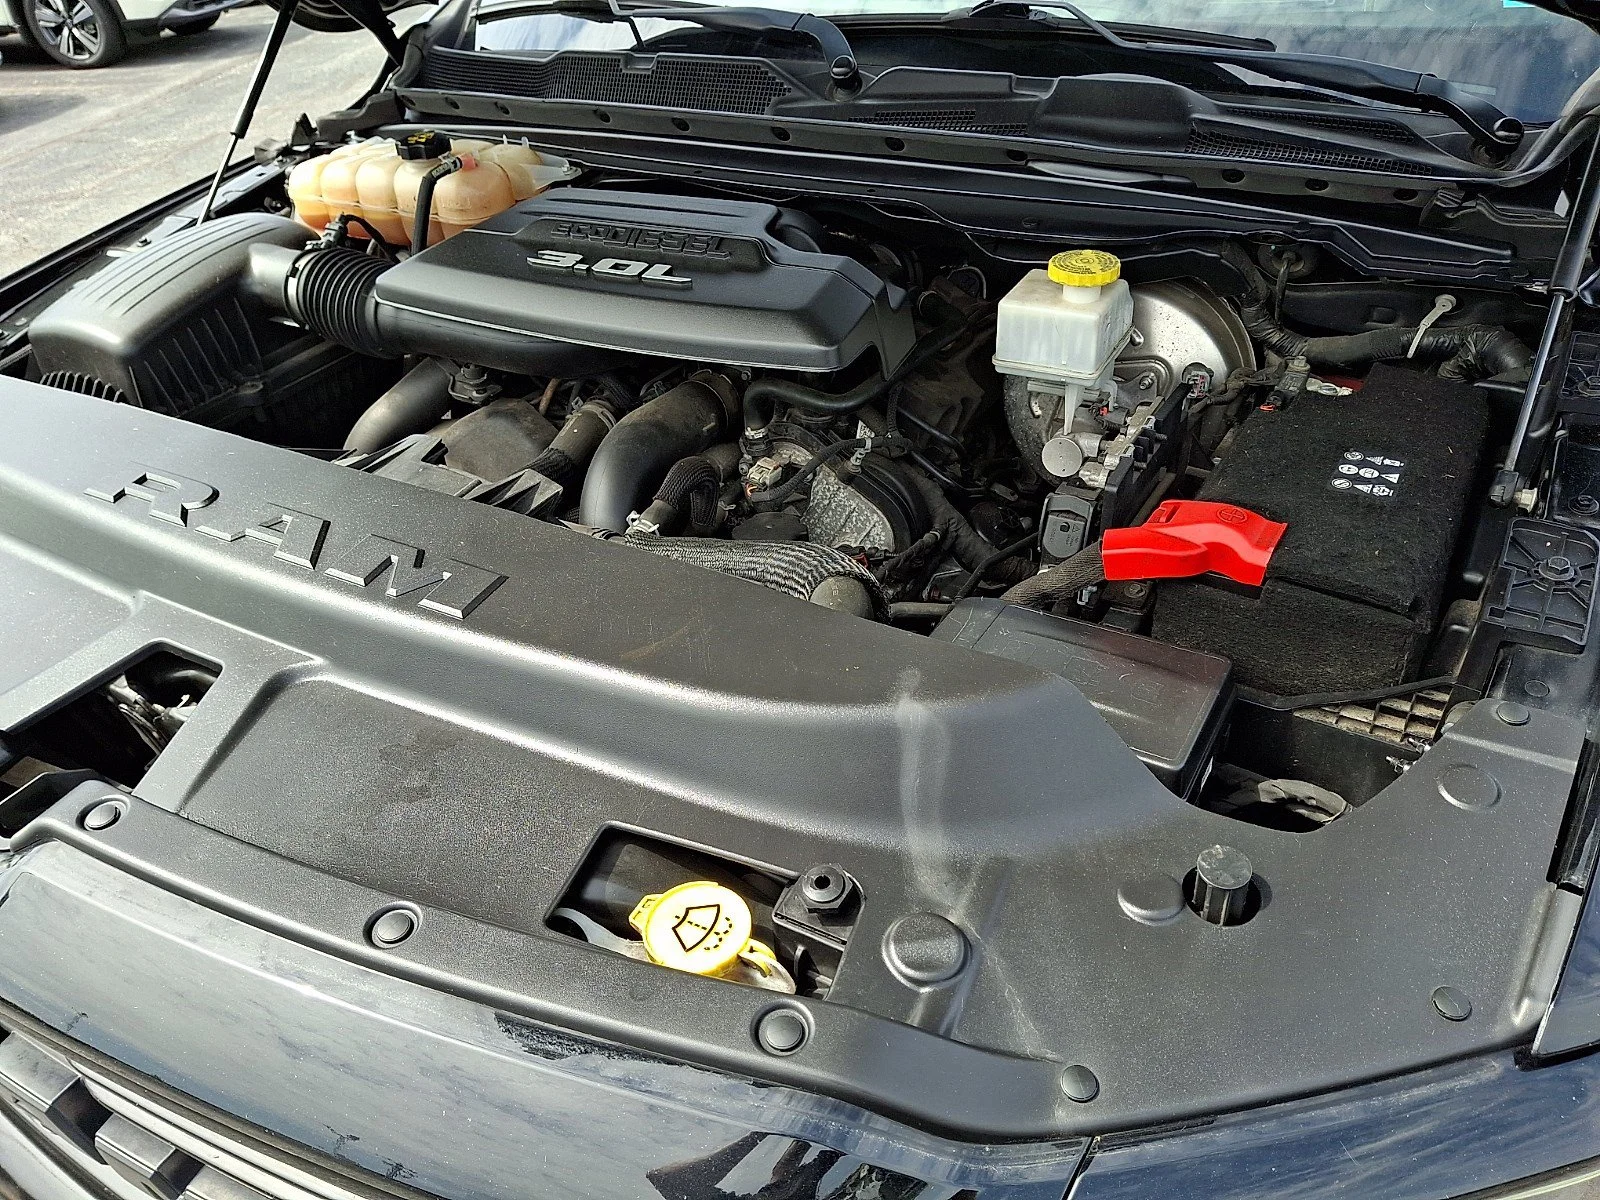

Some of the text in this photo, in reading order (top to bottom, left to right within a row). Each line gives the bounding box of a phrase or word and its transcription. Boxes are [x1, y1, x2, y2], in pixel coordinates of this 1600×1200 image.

[551, 221, 731, 260] ECODIESEL
[526, 249, 693, 290] 3.0L
[83, 462, 509, 619] RAM
